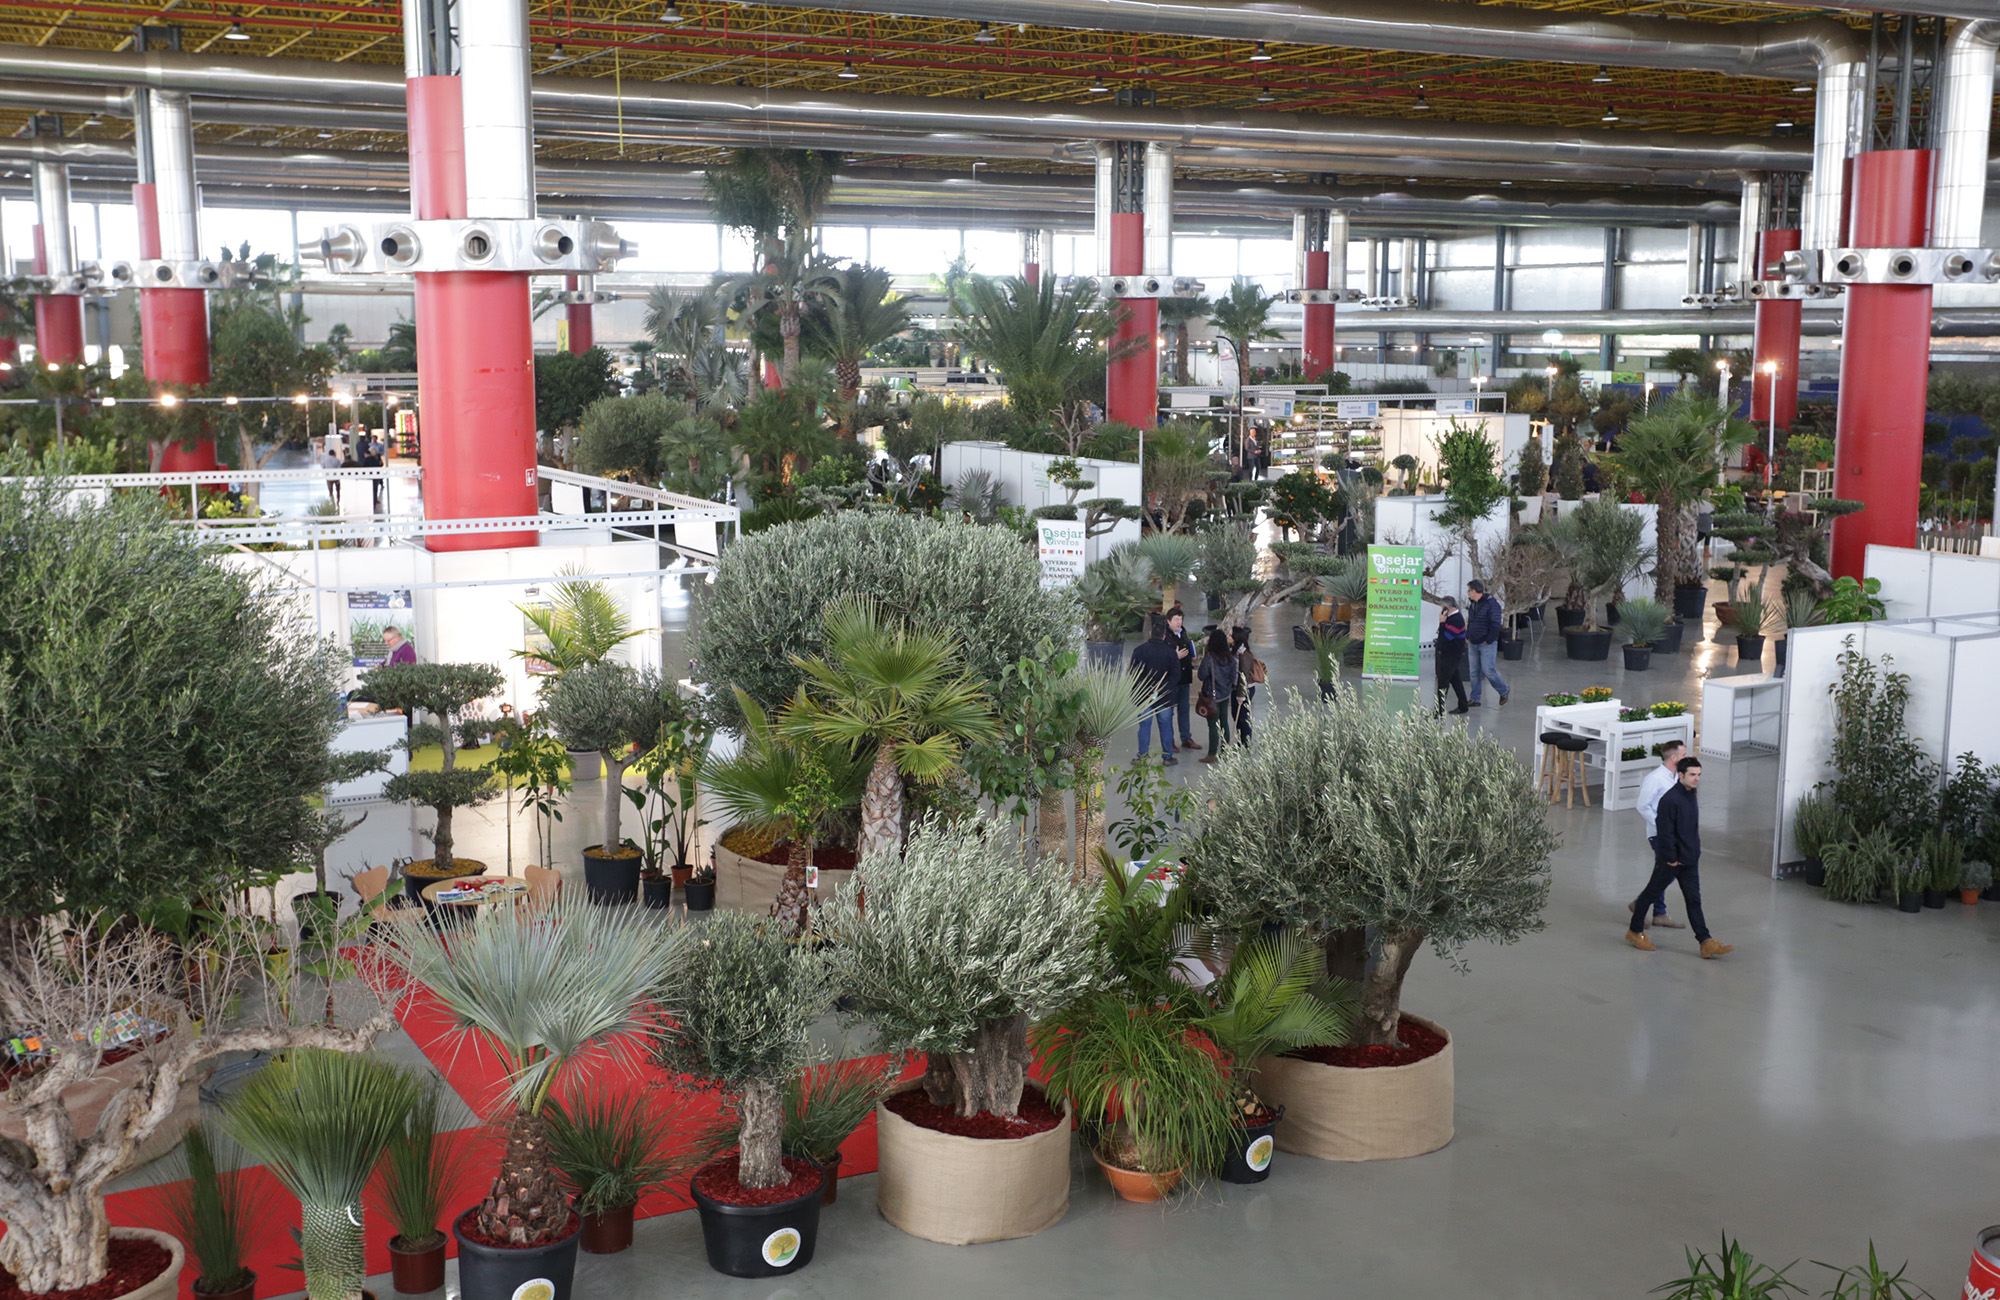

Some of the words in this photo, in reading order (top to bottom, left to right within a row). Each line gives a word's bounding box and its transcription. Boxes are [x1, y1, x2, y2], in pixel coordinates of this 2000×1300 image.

[1041, 528, 1084, 540] asejar
[1046, 538, 1080, 546] viveros
[1371, 554, 1422, 568] asejar
[1377, 566, 1416, 574] viveros
